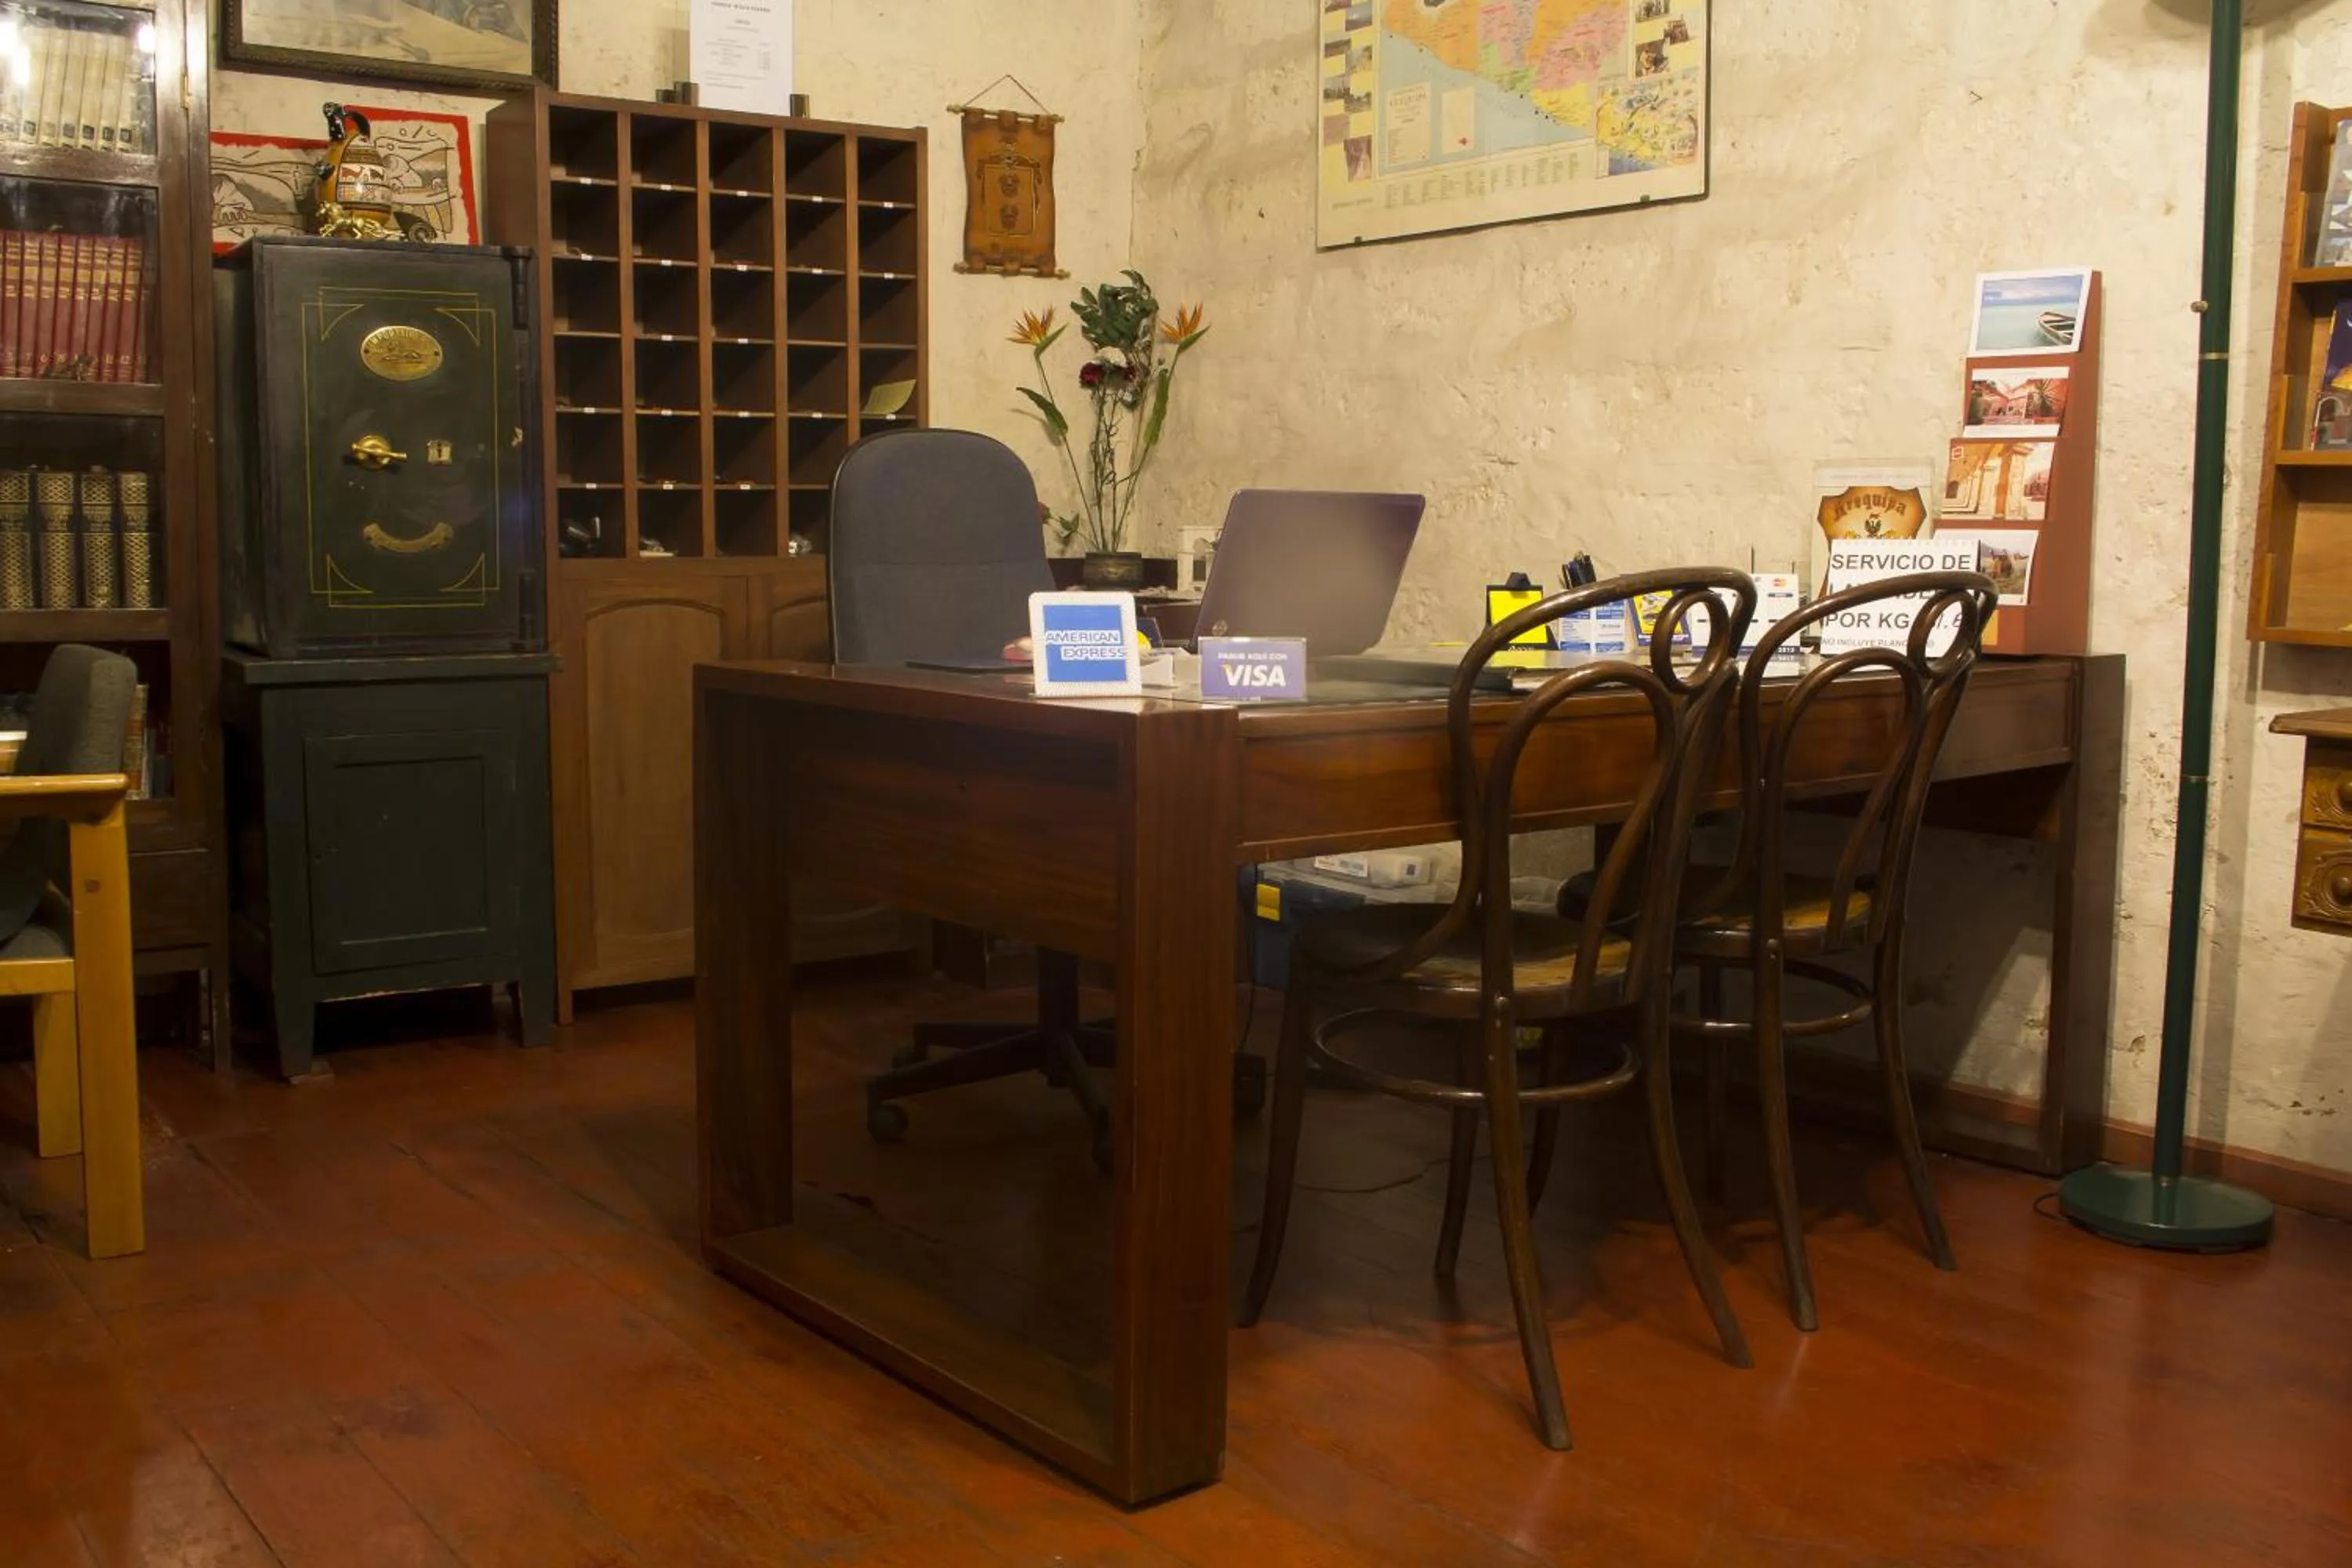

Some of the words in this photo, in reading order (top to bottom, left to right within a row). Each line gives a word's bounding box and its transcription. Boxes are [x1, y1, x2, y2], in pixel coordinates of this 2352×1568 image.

[1831, 554, 1934, 570] SERVICIO
[1942, 554, 1971, 570] DE
[1826, 612, 1871, 628] POR
[1046, 631, 1119, 642] AMERICAN
[1837, 639, 1875, 648] INCLUYE
[1063, 647, 1126, 658] EXPRESS
[1220, 664, 1287, 687] VISA
